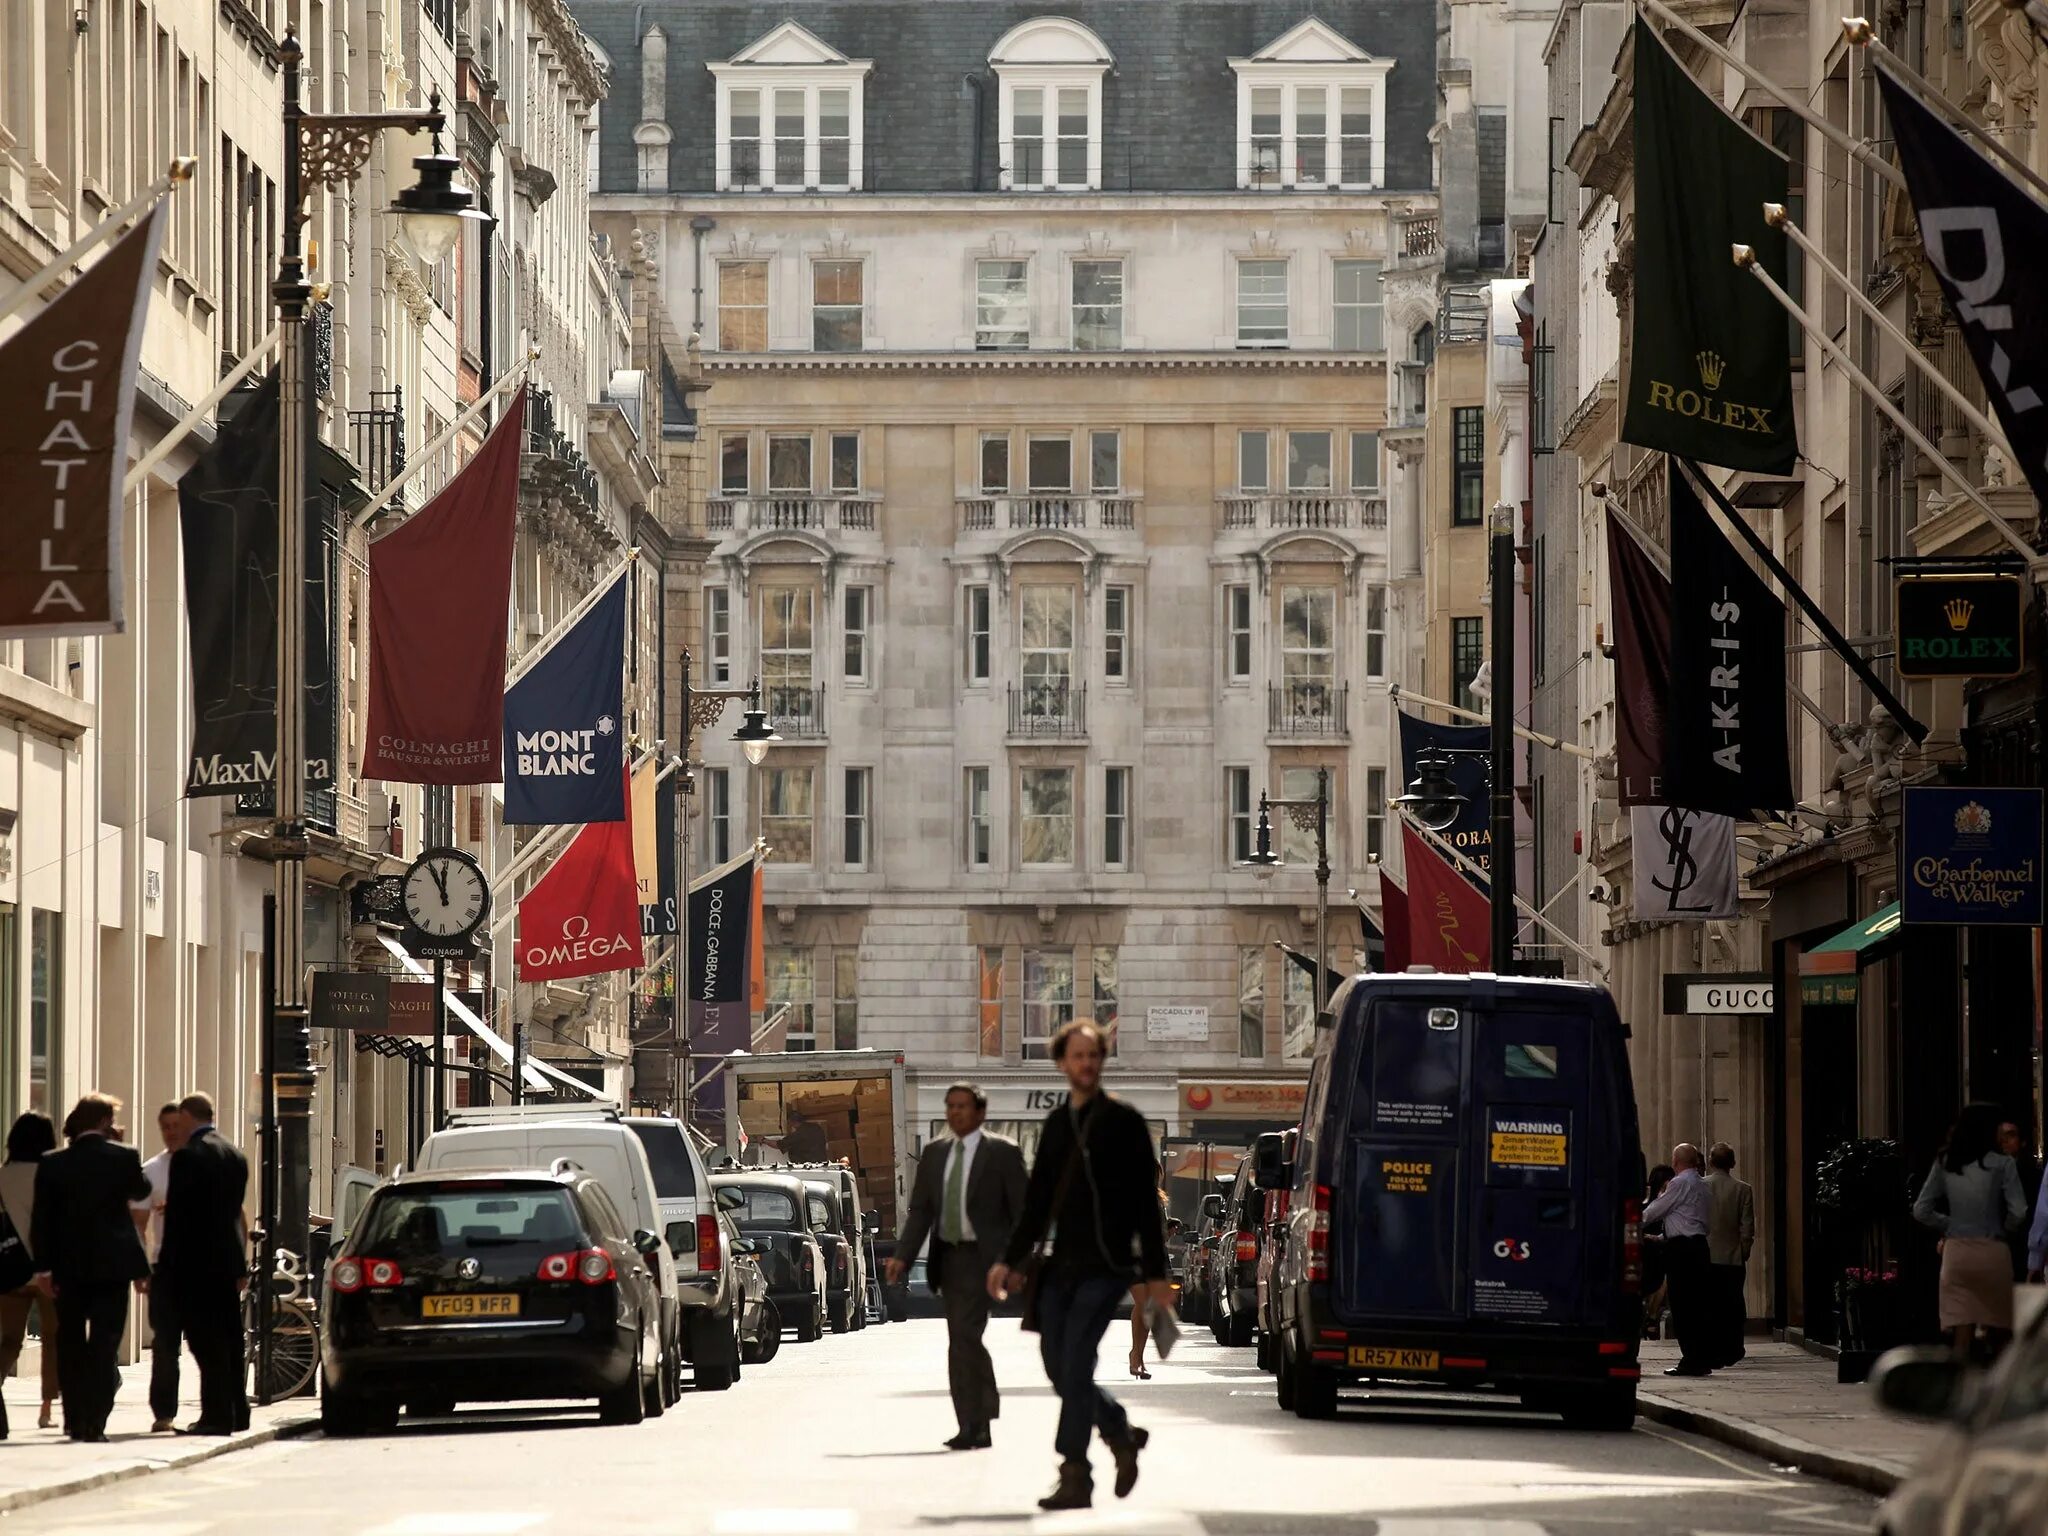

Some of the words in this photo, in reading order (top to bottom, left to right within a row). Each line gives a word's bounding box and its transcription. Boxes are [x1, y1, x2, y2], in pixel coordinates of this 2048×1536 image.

[1647, 380, 1774, 434] ROLEX
[32, 340, 100, 614] CHATILA
[1905, 638, 2014, 659] ROLEX
[378, 735, 490, 755] COLNAGHI
[517, 730, 595, 752] MONT
[189, 749, 330, 788] MaxMra
[518, 753, 596, 776] BLANC
[1913, 856, 2034, 888] Charbonnel
[1931, 881, 1949, 899] et
[1950, 882, 2025, 908] Walker
[708, 889, 723, 930] DOLCE
[421, 947, 464, 956] COLNAGHI
[526, 933, 633, 967] OMEGA
[702, 936, 720, 1000] GABBANA
[1195, 1008, 1205, 1016] W1
[1377, 1101, 1391, 1109] This
[1495, 1121, 1563, 1134] WARNING
[1503, 1135, 1556, 1145] SmartWater
[1498, 1152, 1530, 1161] system
[1382, 1161, 1432, 1175] POLICE
[1390, 1175, 1424, 1184] FOLLOW
[1410, 1184, 1428, 1192] VAN
[430, 1297, 474, 1313] YF09
[479, 1296, 512, 1312] WFR
[1354, 1349, 1398, 1366] LR57
[1401, 1351, 1433, 1367] KNY
